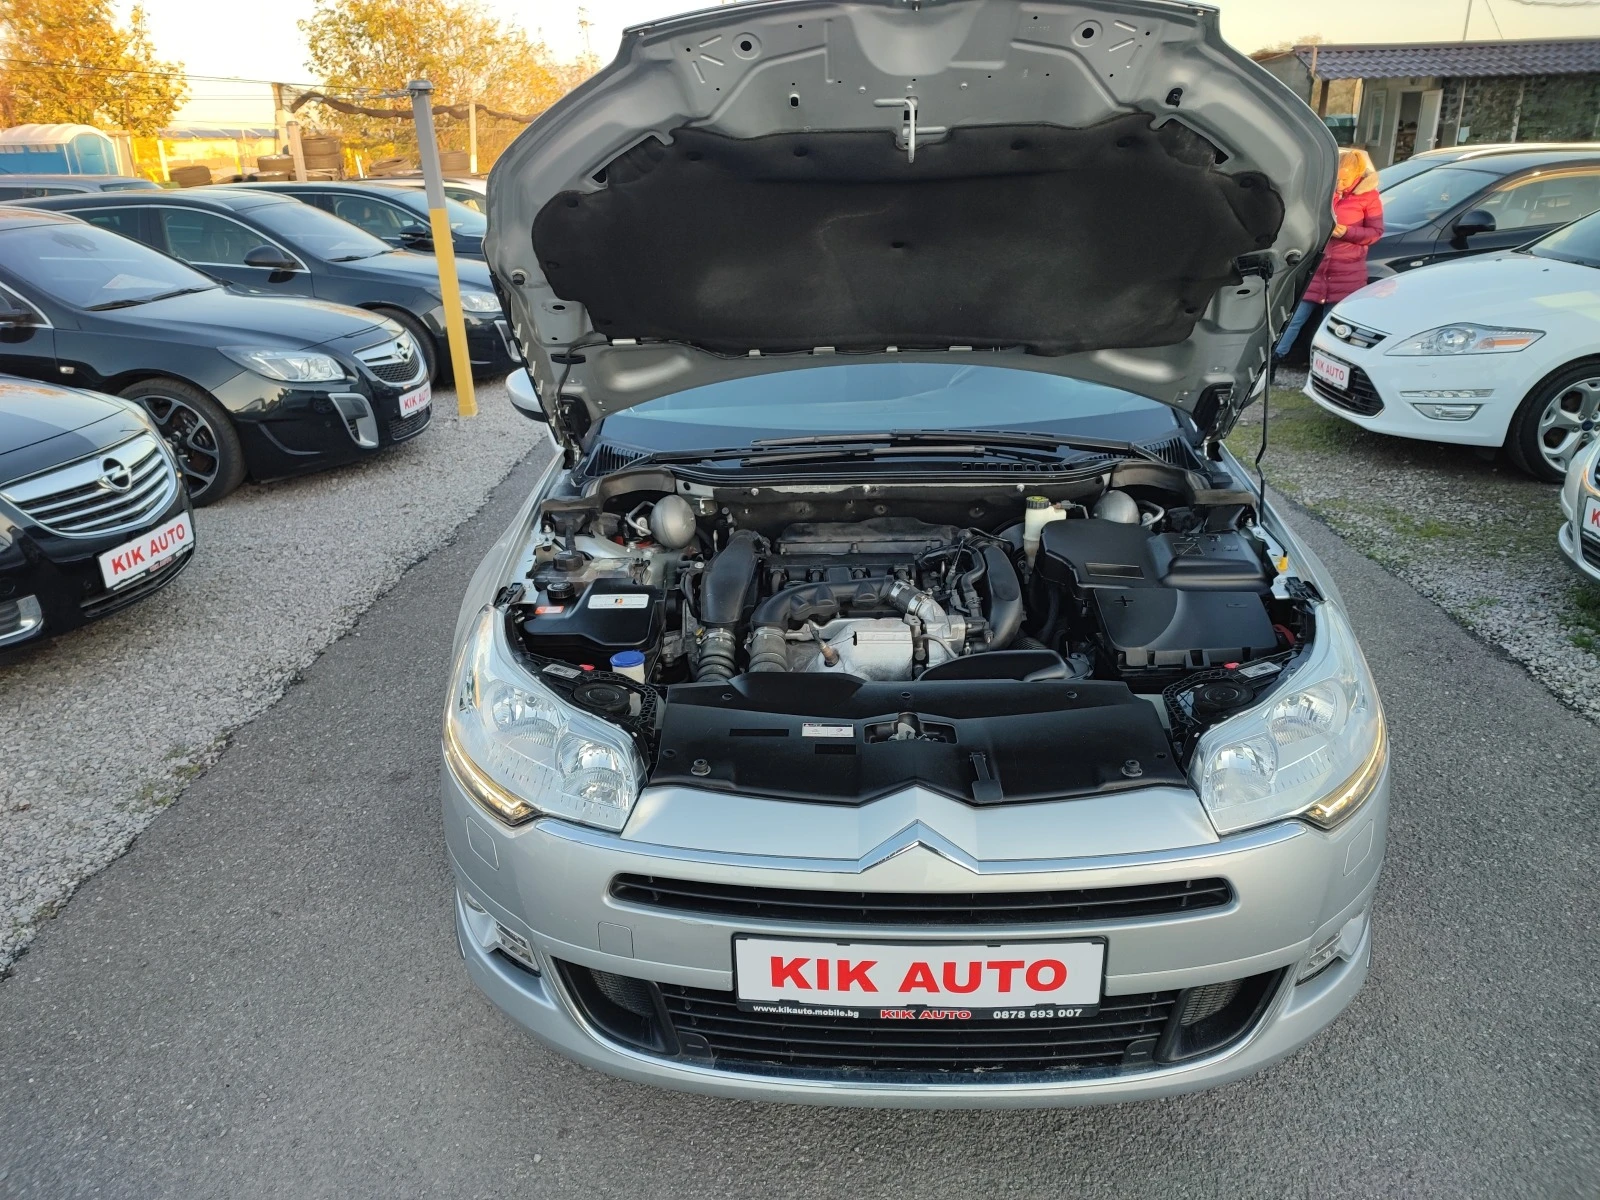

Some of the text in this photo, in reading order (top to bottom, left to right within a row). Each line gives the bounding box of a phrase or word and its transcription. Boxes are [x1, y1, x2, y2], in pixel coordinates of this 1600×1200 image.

[1326, 364, 1344, 381] AUTO
[404, 395, 417, 410] KIK
[111, 545, 145, 575] KIK
[150, 523, 185, 557] AUTO
[770, 956, 1068, 994] KIK AUTO
[753, 1004, 859, 1019] www.kikauto.mobile.bg
[880, 1009, 972, 1020] KIK AUTO
[993, 1008, 1083, 1020] 0878 693 007
